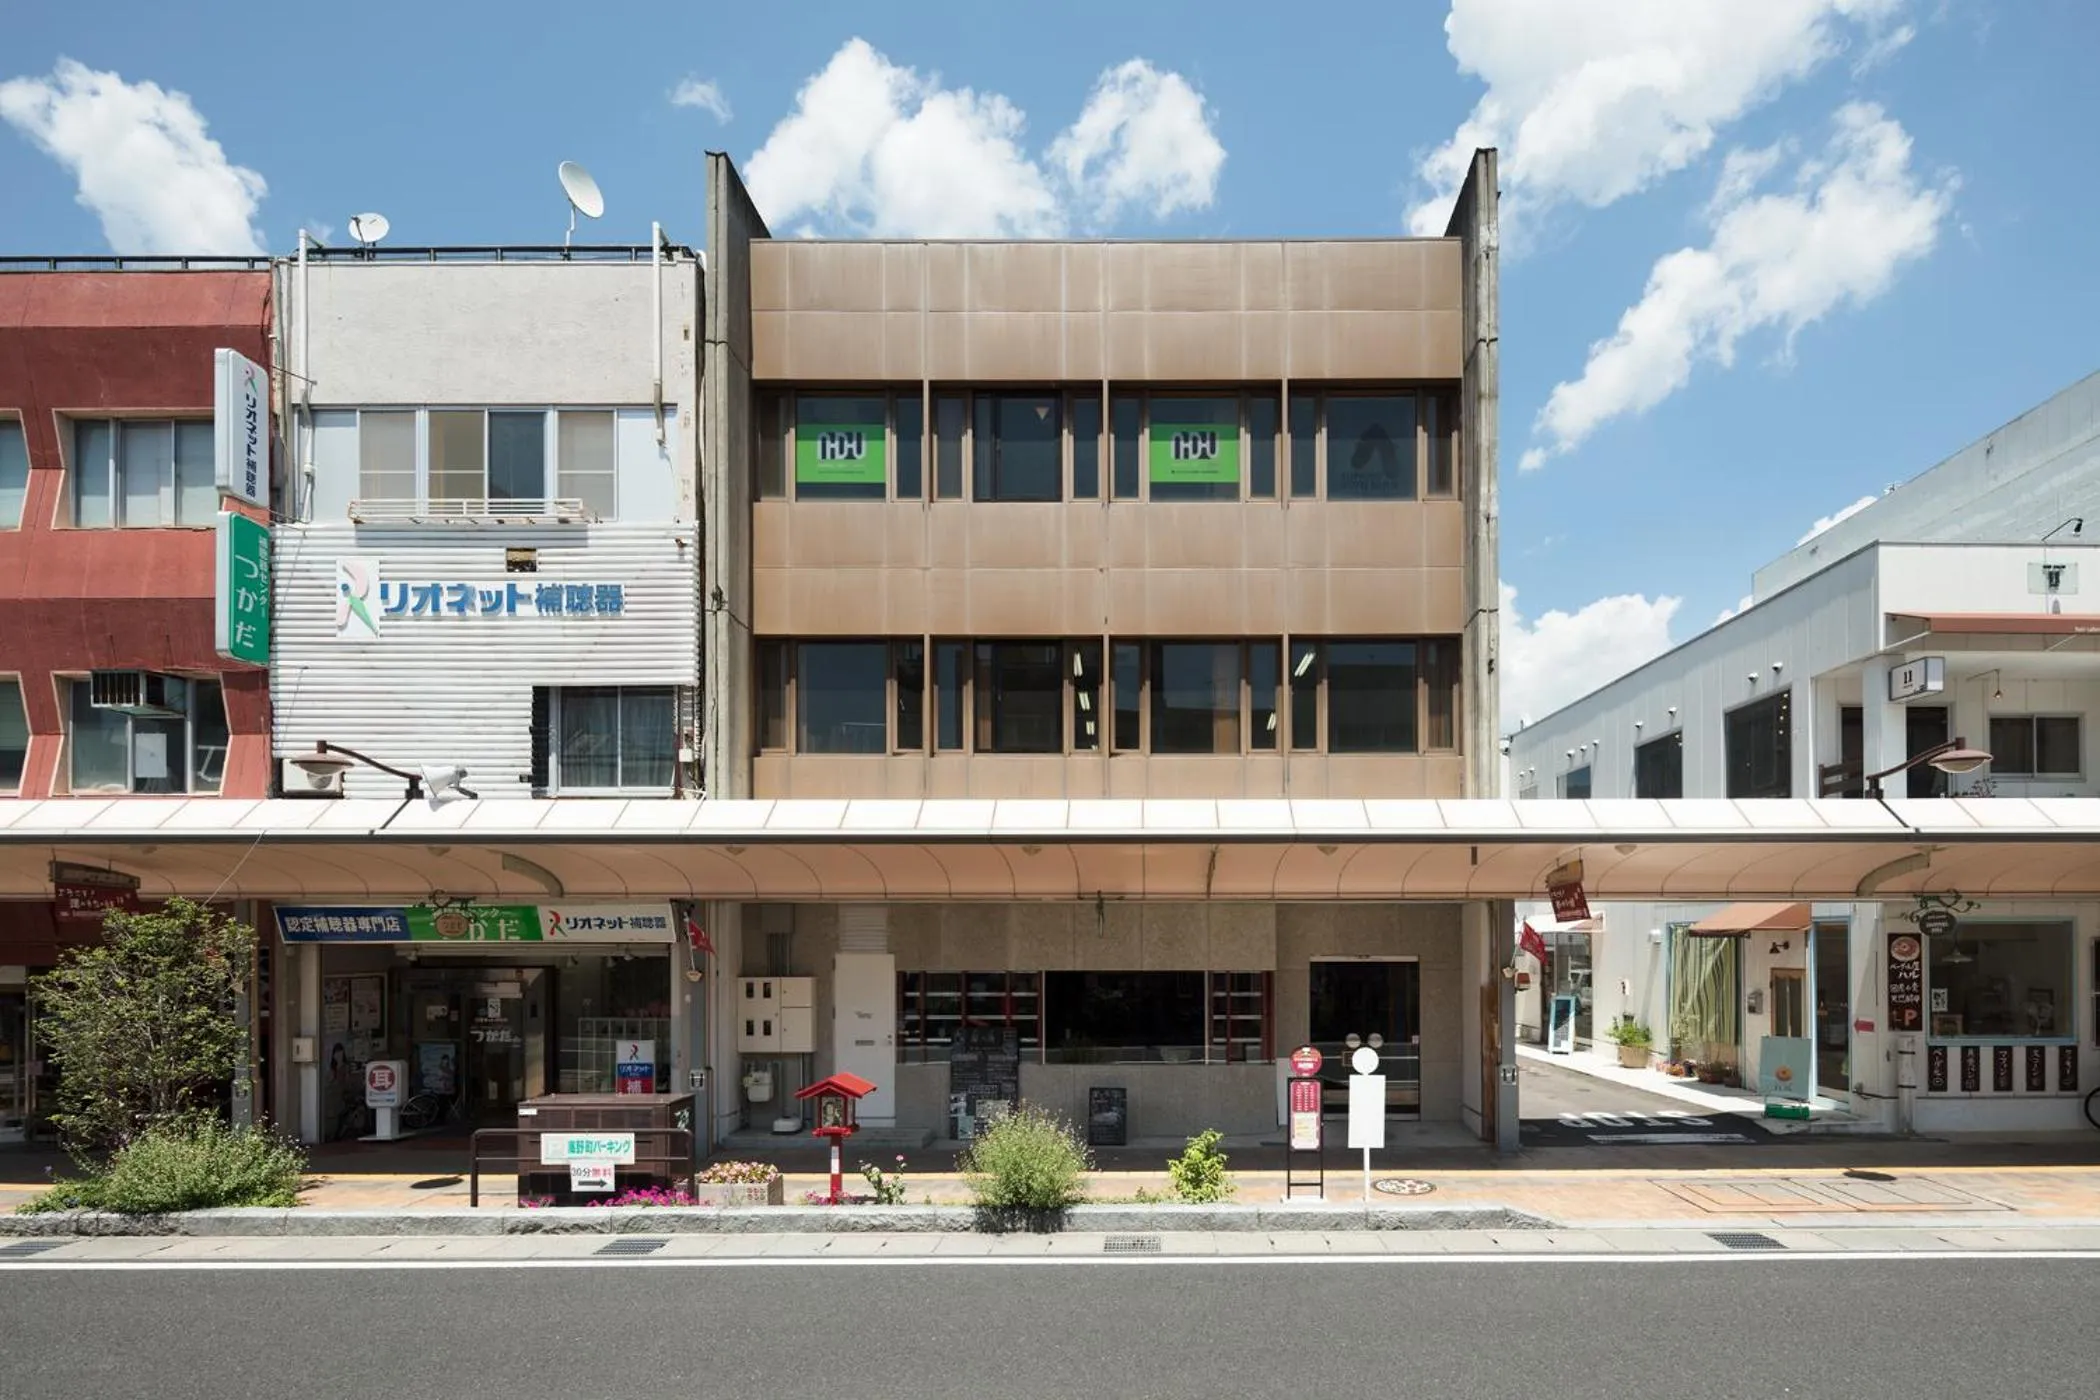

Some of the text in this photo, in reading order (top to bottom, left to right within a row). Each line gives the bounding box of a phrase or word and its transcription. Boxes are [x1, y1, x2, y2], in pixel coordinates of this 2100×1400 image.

[235, 554, 259, 648] つかだ
[380, 583, 624, 614] リオネット補聴器
[284, 916, 402, 933] 認定補聴器専門店
[565, 917, 667, 930] リオネット補聴器
[1904, 1009, 1918, 1026] P
[372, 1069, 393, 1089] 耳
